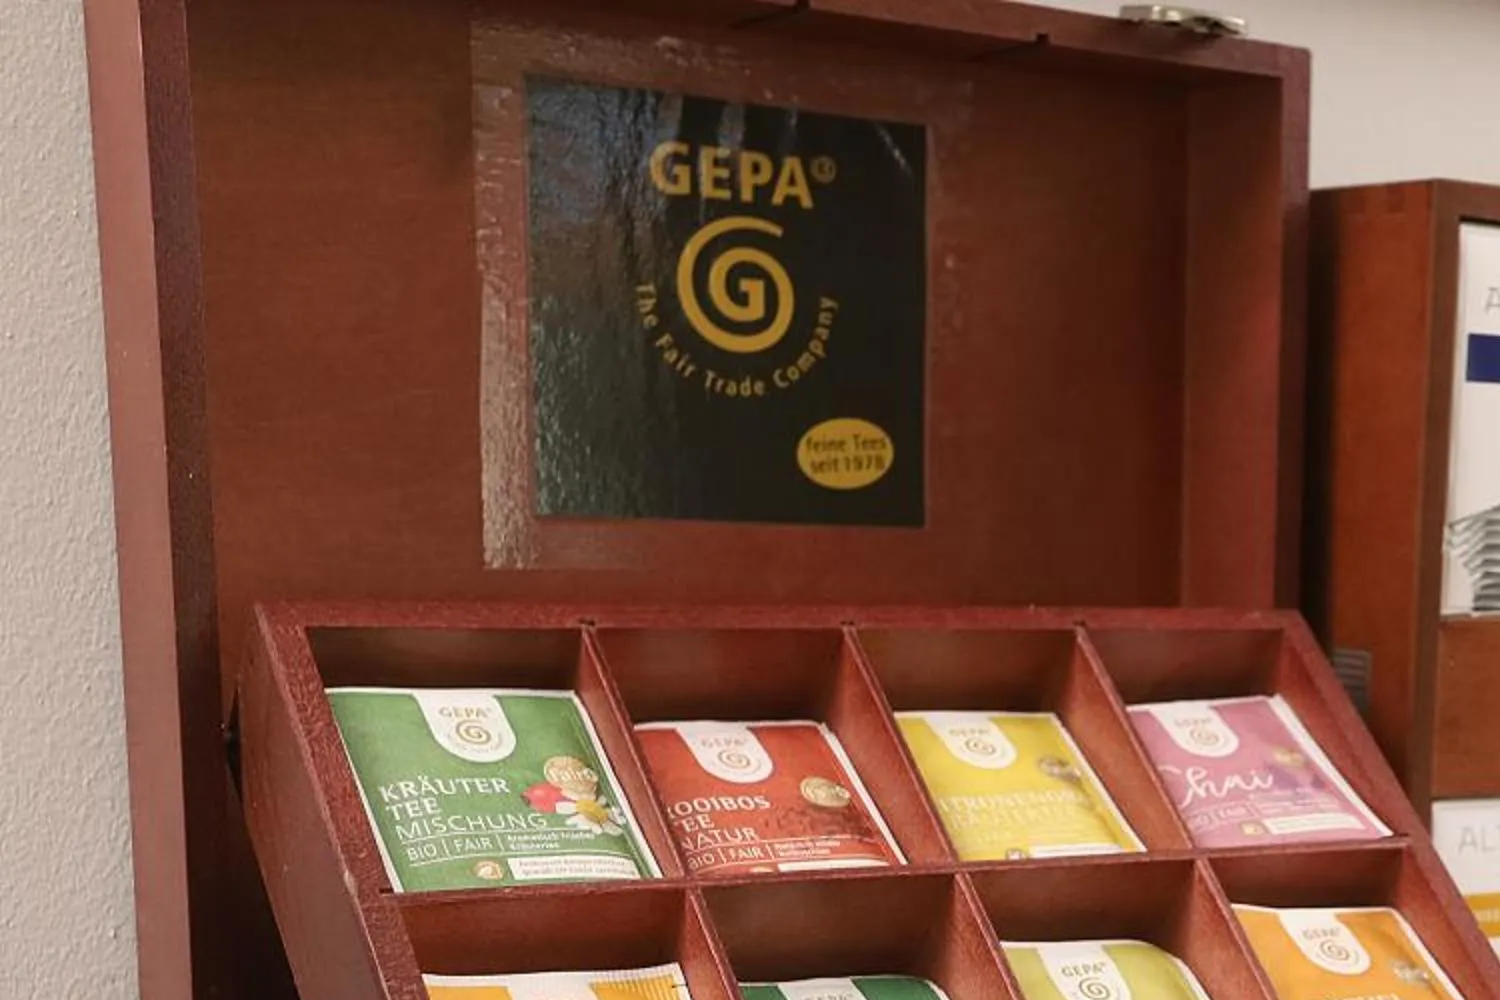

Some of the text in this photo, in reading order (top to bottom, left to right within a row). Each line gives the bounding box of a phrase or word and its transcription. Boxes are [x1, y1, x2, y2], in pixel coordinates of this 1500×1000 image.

[636, 283, 839, 397] The Fair Trade Company
[810, 457, 841, 474] seit
[379, 775, 511, 802] KRÄUTER
[385, 797, 443, 822] TEE
[395, 813, 549, 840] MISCHUNG
[407, 834, 494, 862] BIO FAIR
[729, 845, 765, 862] FAIR
[1061, 963, 1106, 978] GEPA
